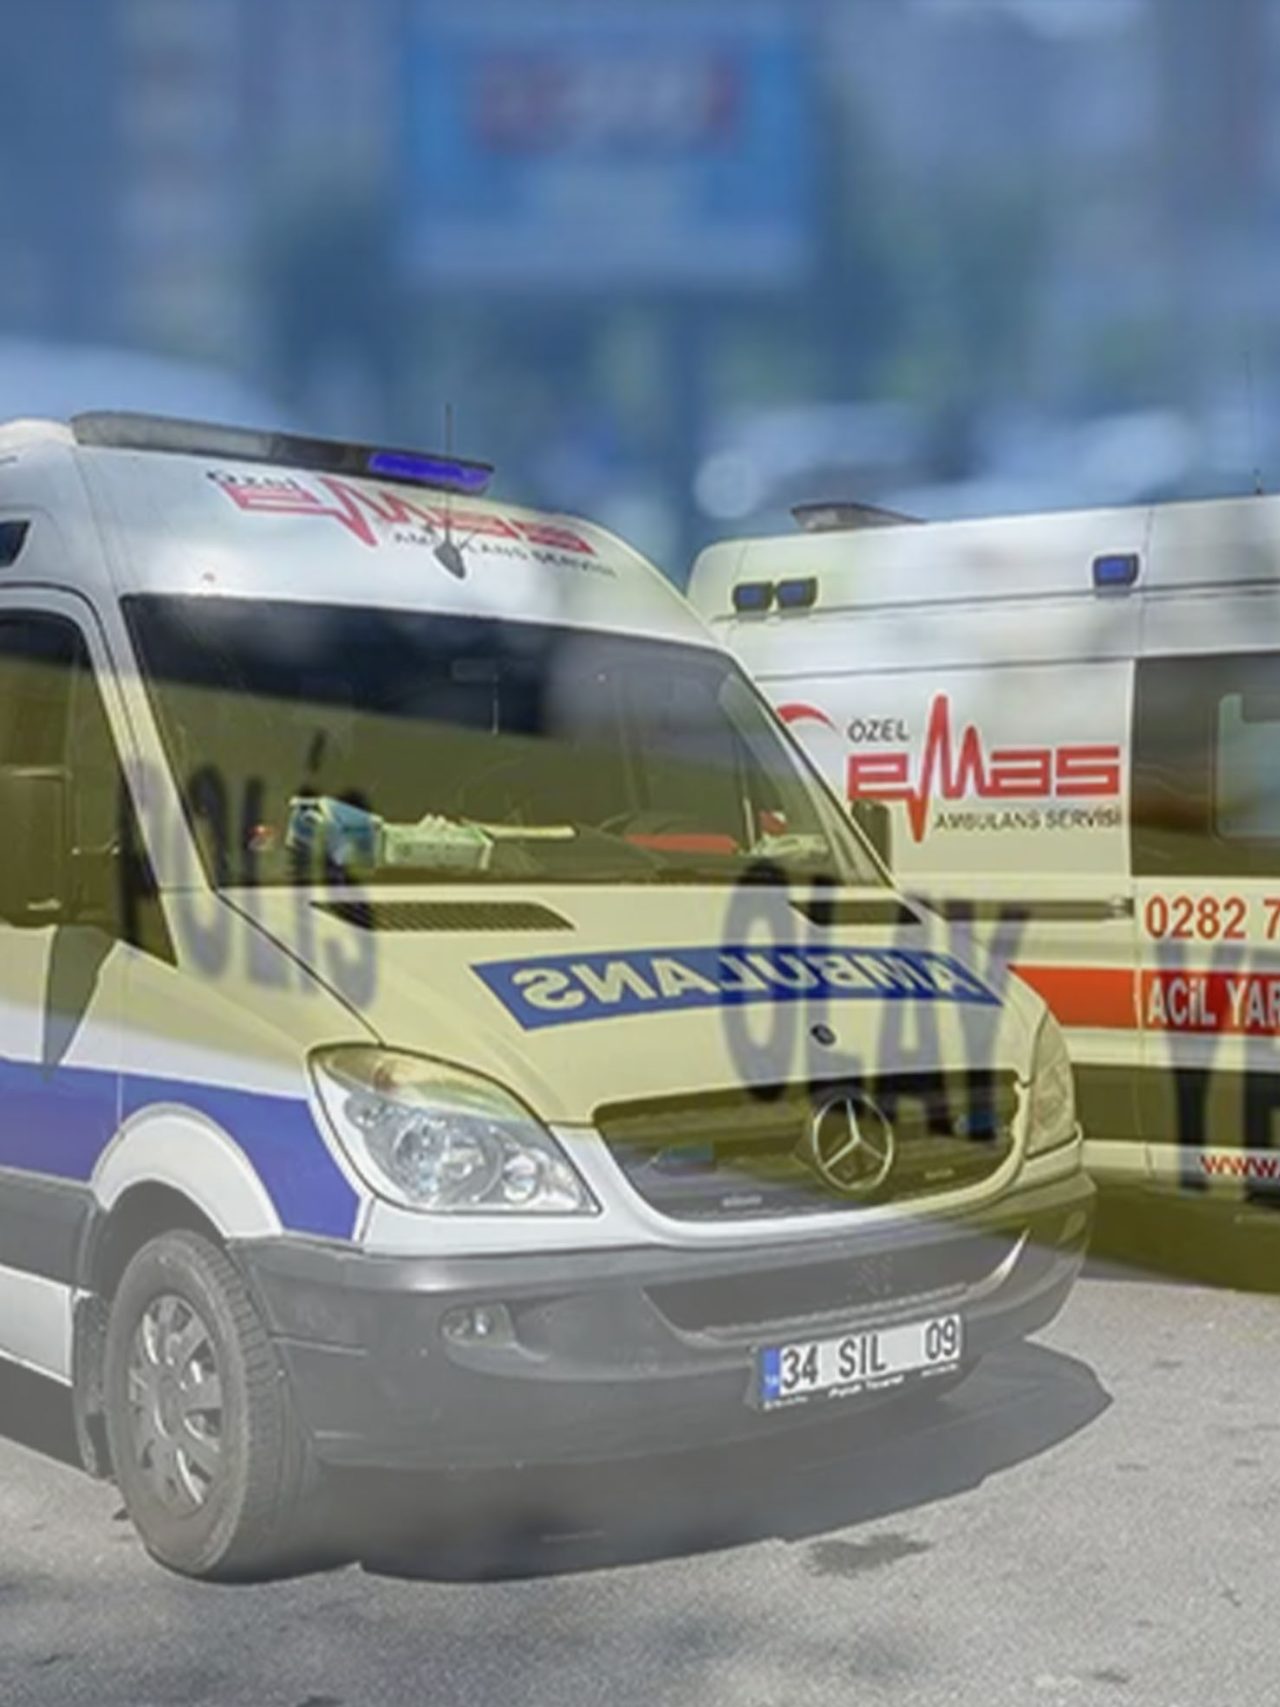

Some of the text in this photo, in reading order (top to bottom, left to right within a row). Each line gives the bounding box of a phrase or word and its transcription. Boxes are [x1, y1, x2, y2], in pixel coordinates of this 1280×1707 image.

[1144, 894, 1247, 940] 0282
[782, 1344, 819, 1390] 34
[838, 1333, 887, 1378] SIL
[925, 1317, 957, 1361] 09
